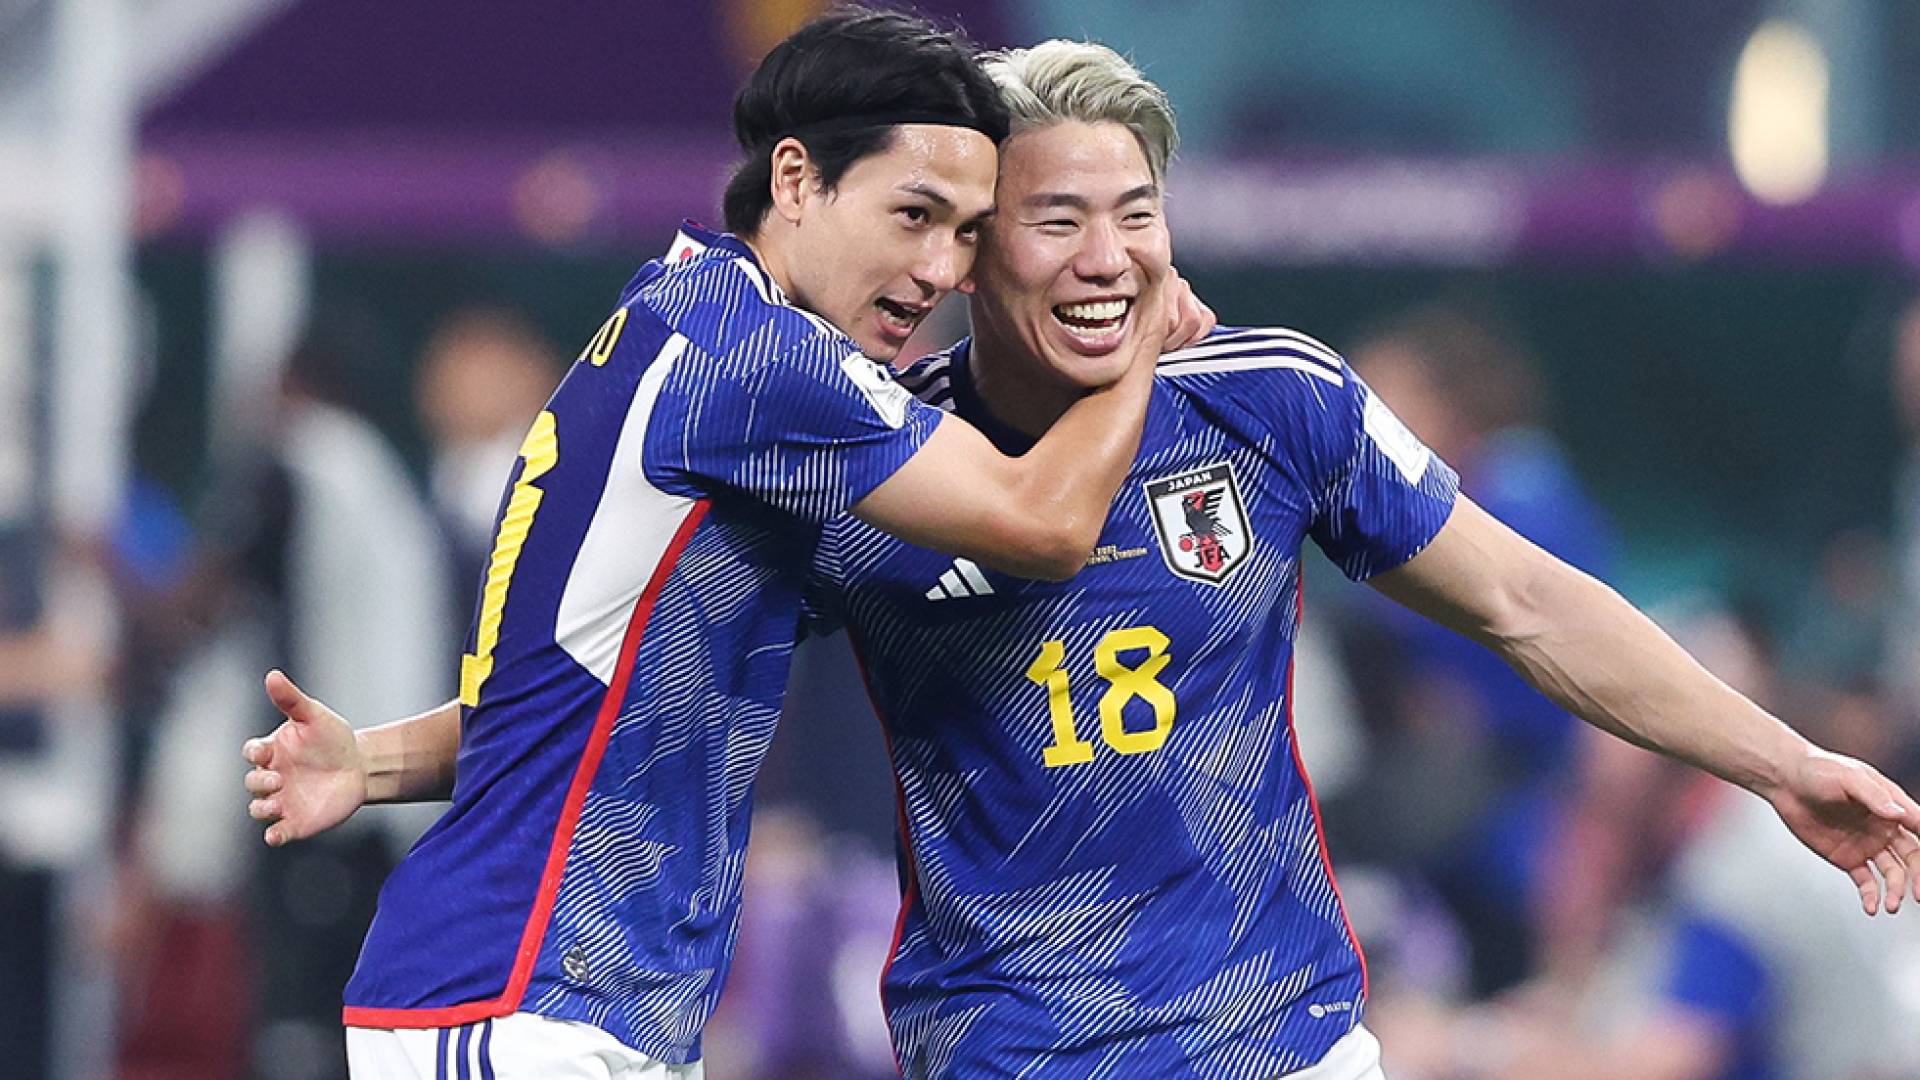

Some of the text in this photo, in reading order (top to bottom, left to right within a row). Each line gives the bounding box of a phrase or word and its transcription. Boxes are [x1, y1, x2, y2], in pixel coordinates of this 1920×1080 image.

[1167, 470, 1213, 492] JAPAN
[1194, 545, 1231, 569] JFA
[1025, 626, 1176, 767] 18
